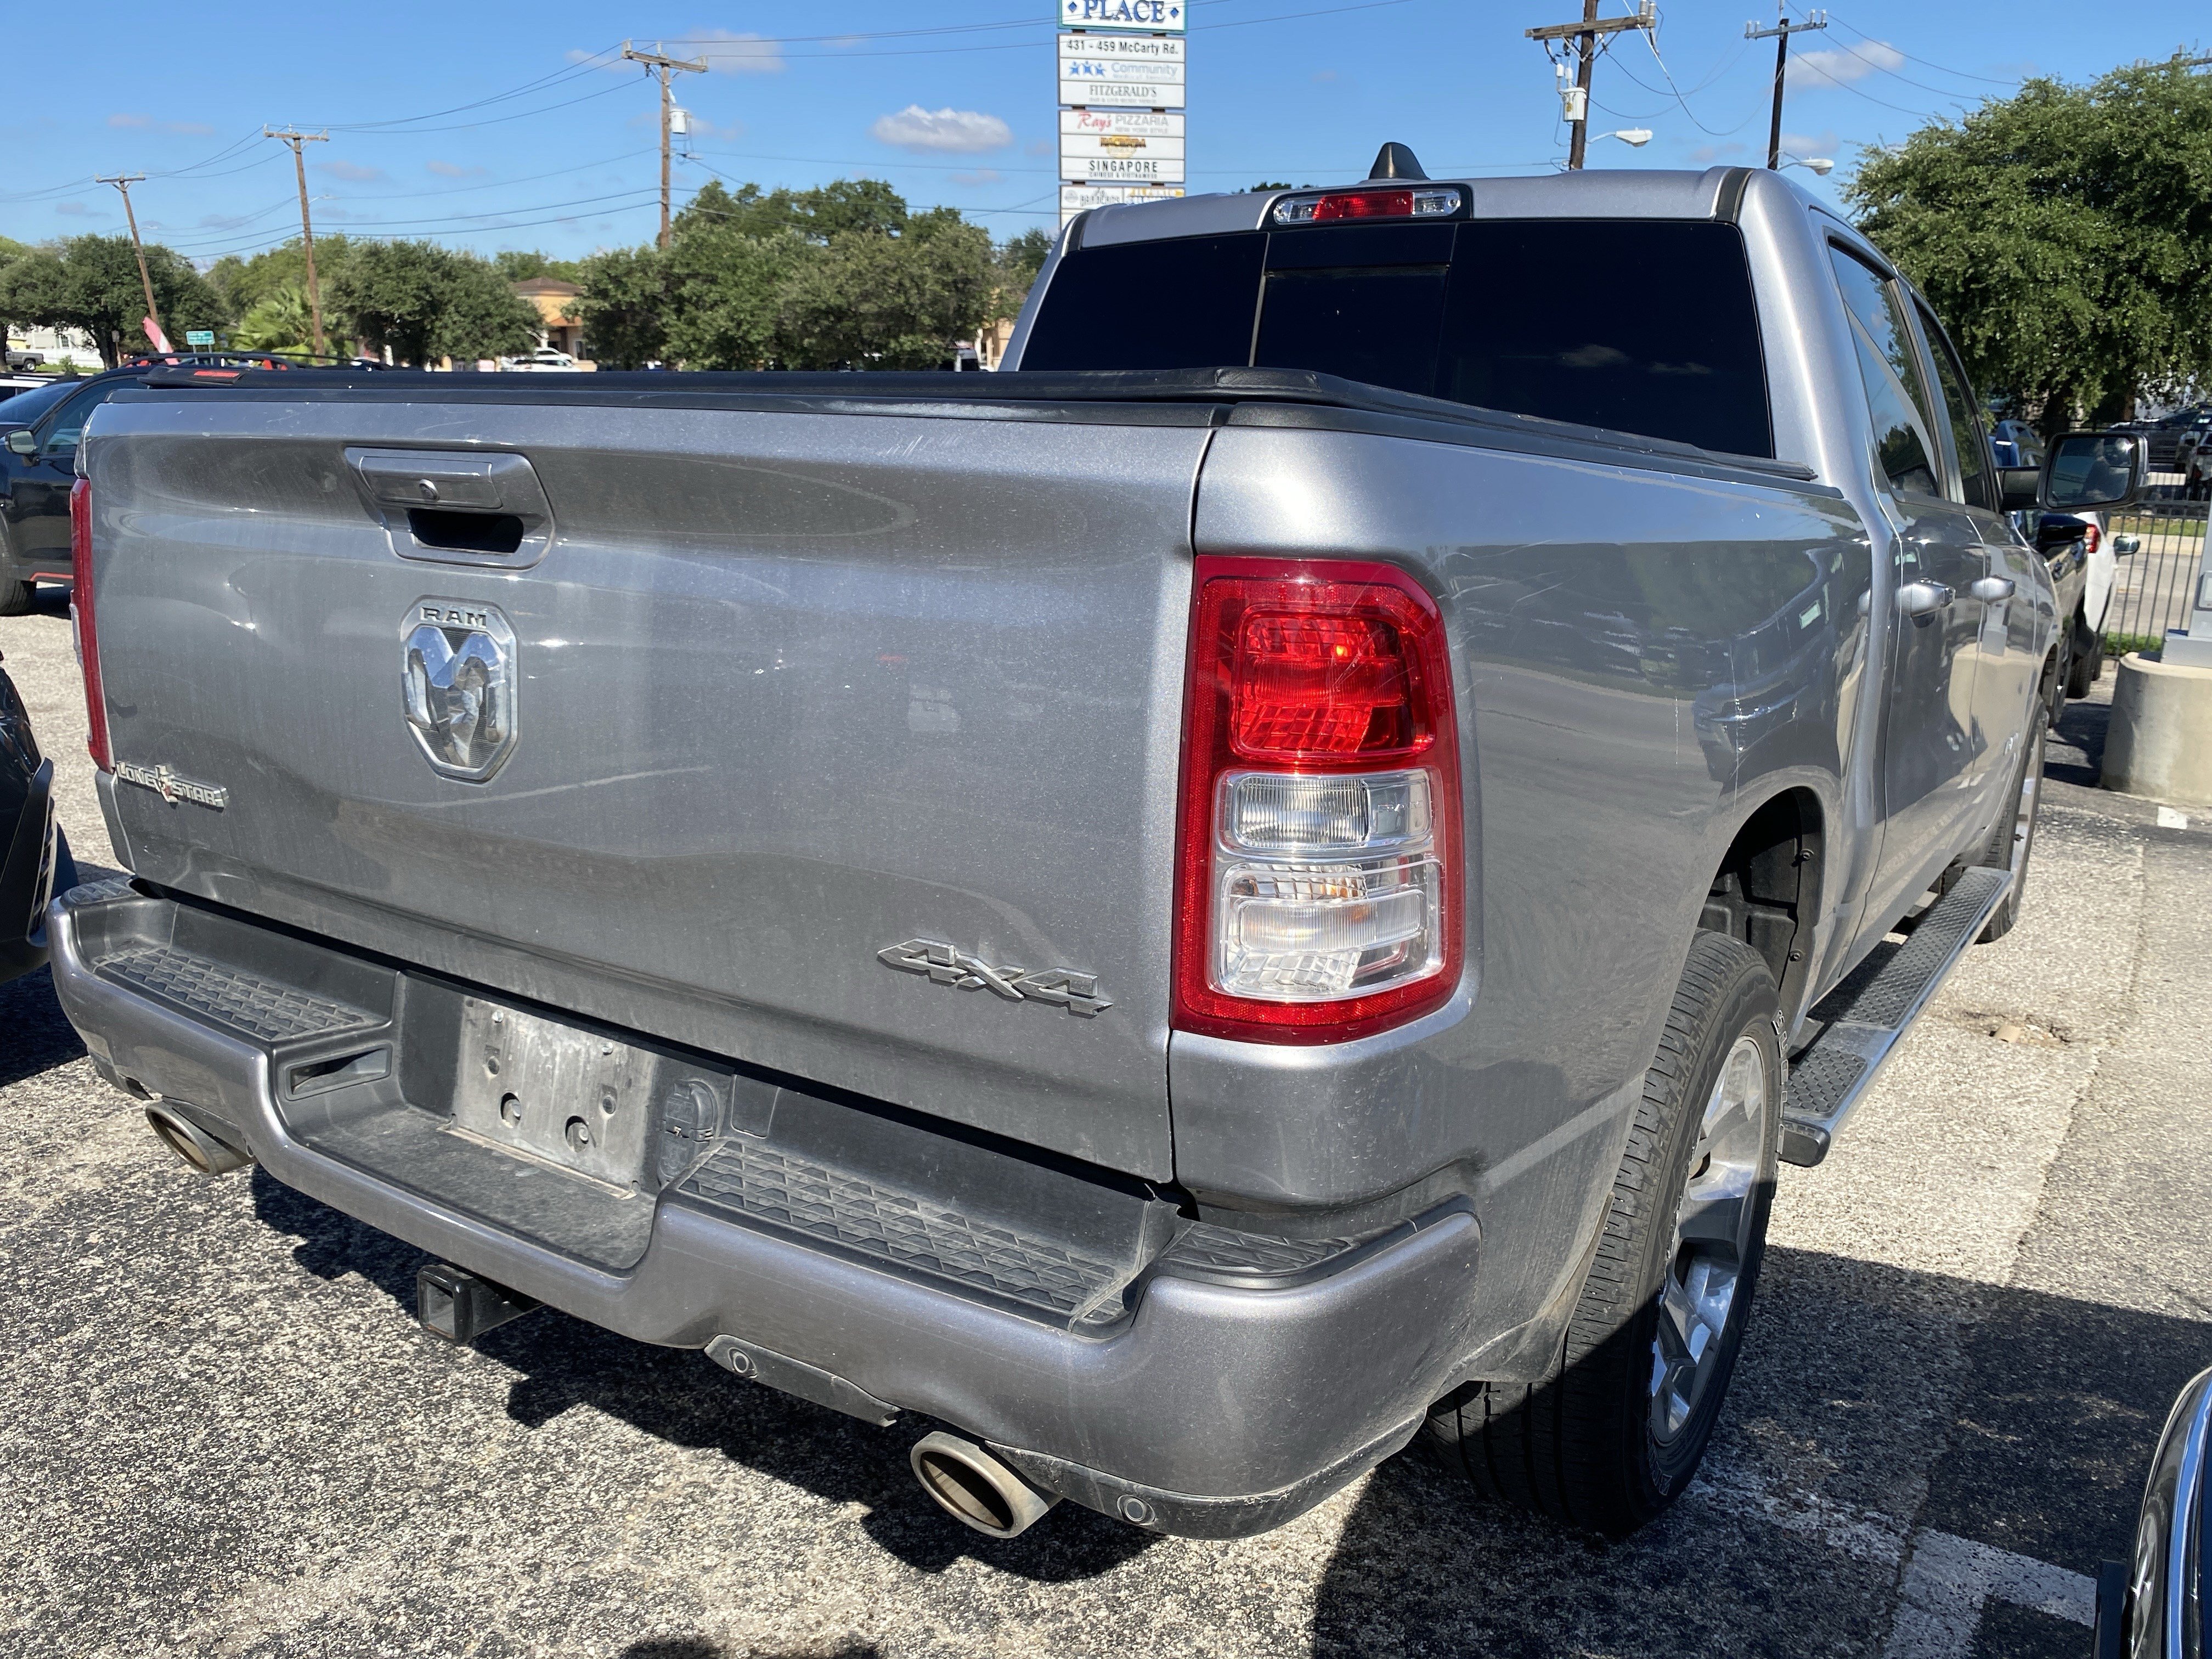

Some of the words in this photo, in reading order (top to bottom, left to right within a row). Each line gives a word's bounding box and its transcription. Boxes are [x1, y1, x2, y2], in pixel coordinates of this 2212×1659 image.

[1083, 0, 1166, 23] PLACE
[1066, 40, 1085, 50] 431
[1097, 41, 1115, 52] 459
[1119, 42, 1159, 55] McCarty
[1111, 63, 1178, 77] Community
[1089, 85, 1157, 98] FITZGERALD'S
[1090, 160, 1158, 172] SINGAPORE
[420, 607, 488, 629] RAM
[116, 760, 159, 788] LONE
[171, 779, 217, 807] STAR
